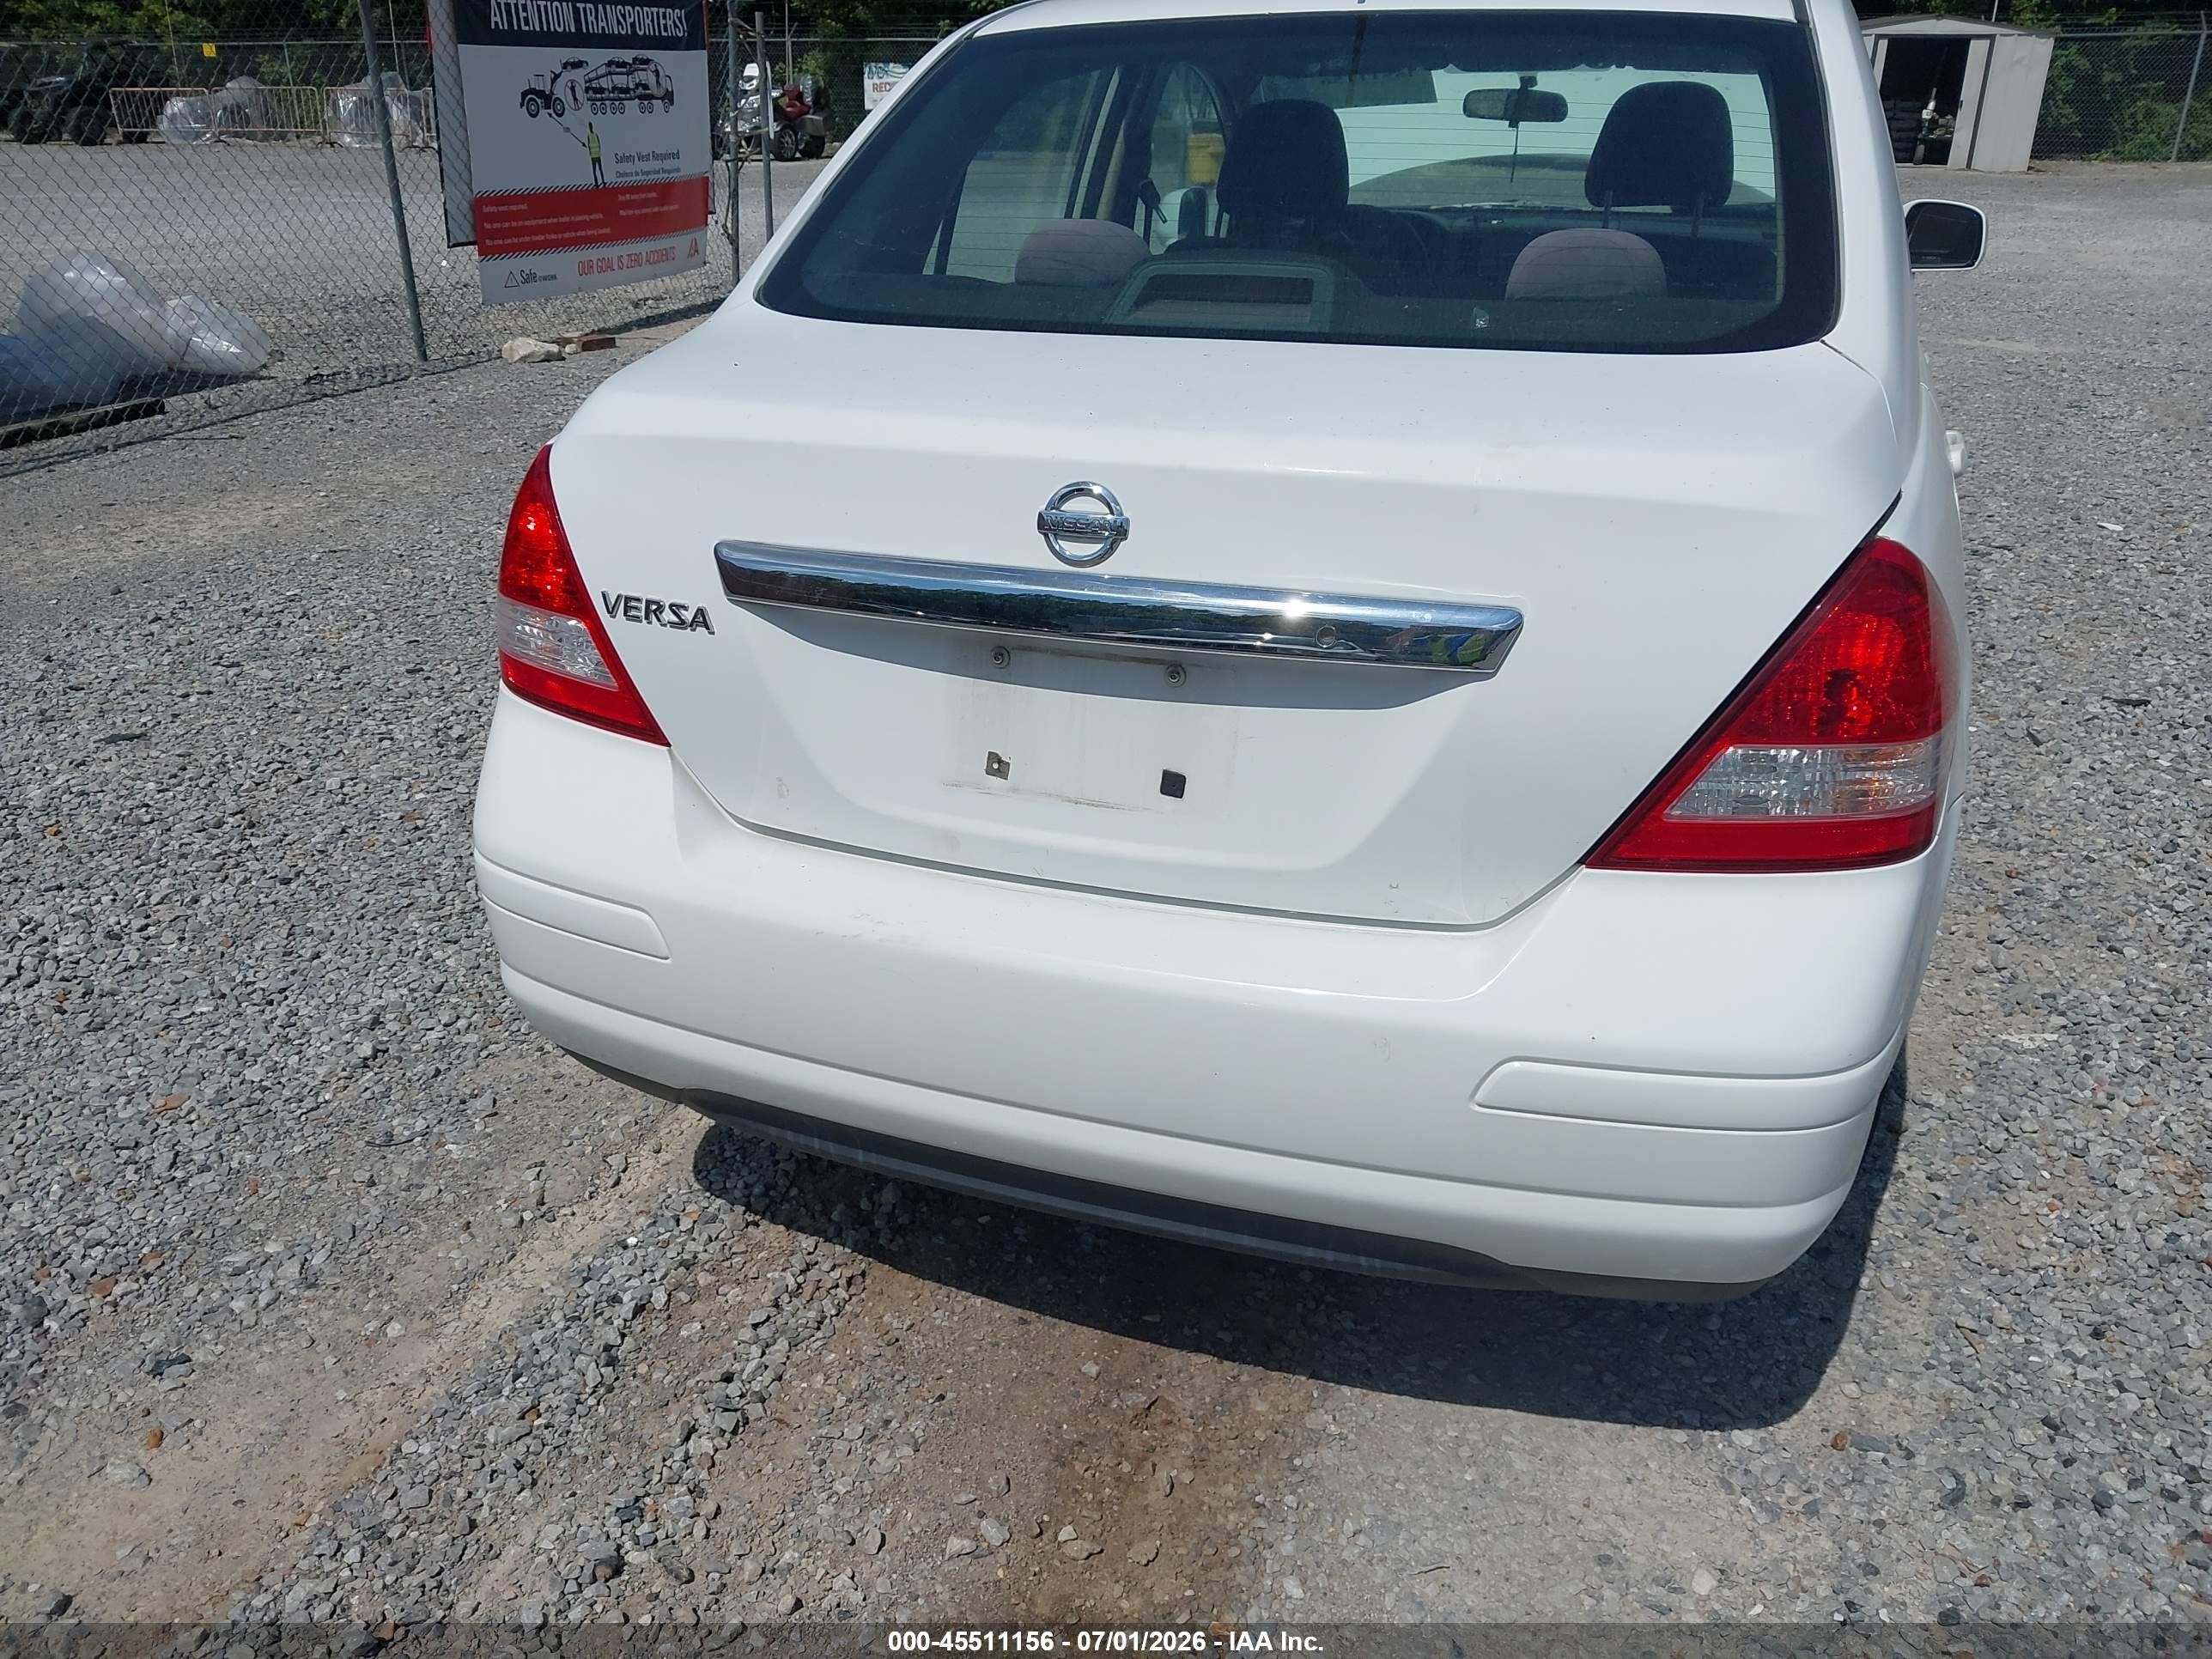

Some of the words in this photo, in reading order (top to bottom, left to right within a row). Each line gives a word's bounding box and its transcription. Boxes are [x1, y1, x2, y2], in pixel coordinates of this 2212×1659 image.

[490, 0, 576, 33] ATTENTION
[576, 3, 688, 37] TRANSPORTERS!
[614, 152, 635, 165] Safety
[636, 150, 651, 162] Vest
[652, 149, 680, 163] Required
[578, 260, 594, 276] OUR
[596, 258, 615, 273] GOAL
[617, 255, 624, 270] IS
[626, 252, 643, 269] ZERO
[520, 268, 538, 284] Safe
[1043, 515, 1119, 535] NISSAN
[601, 591, 715, 635] VERSA
